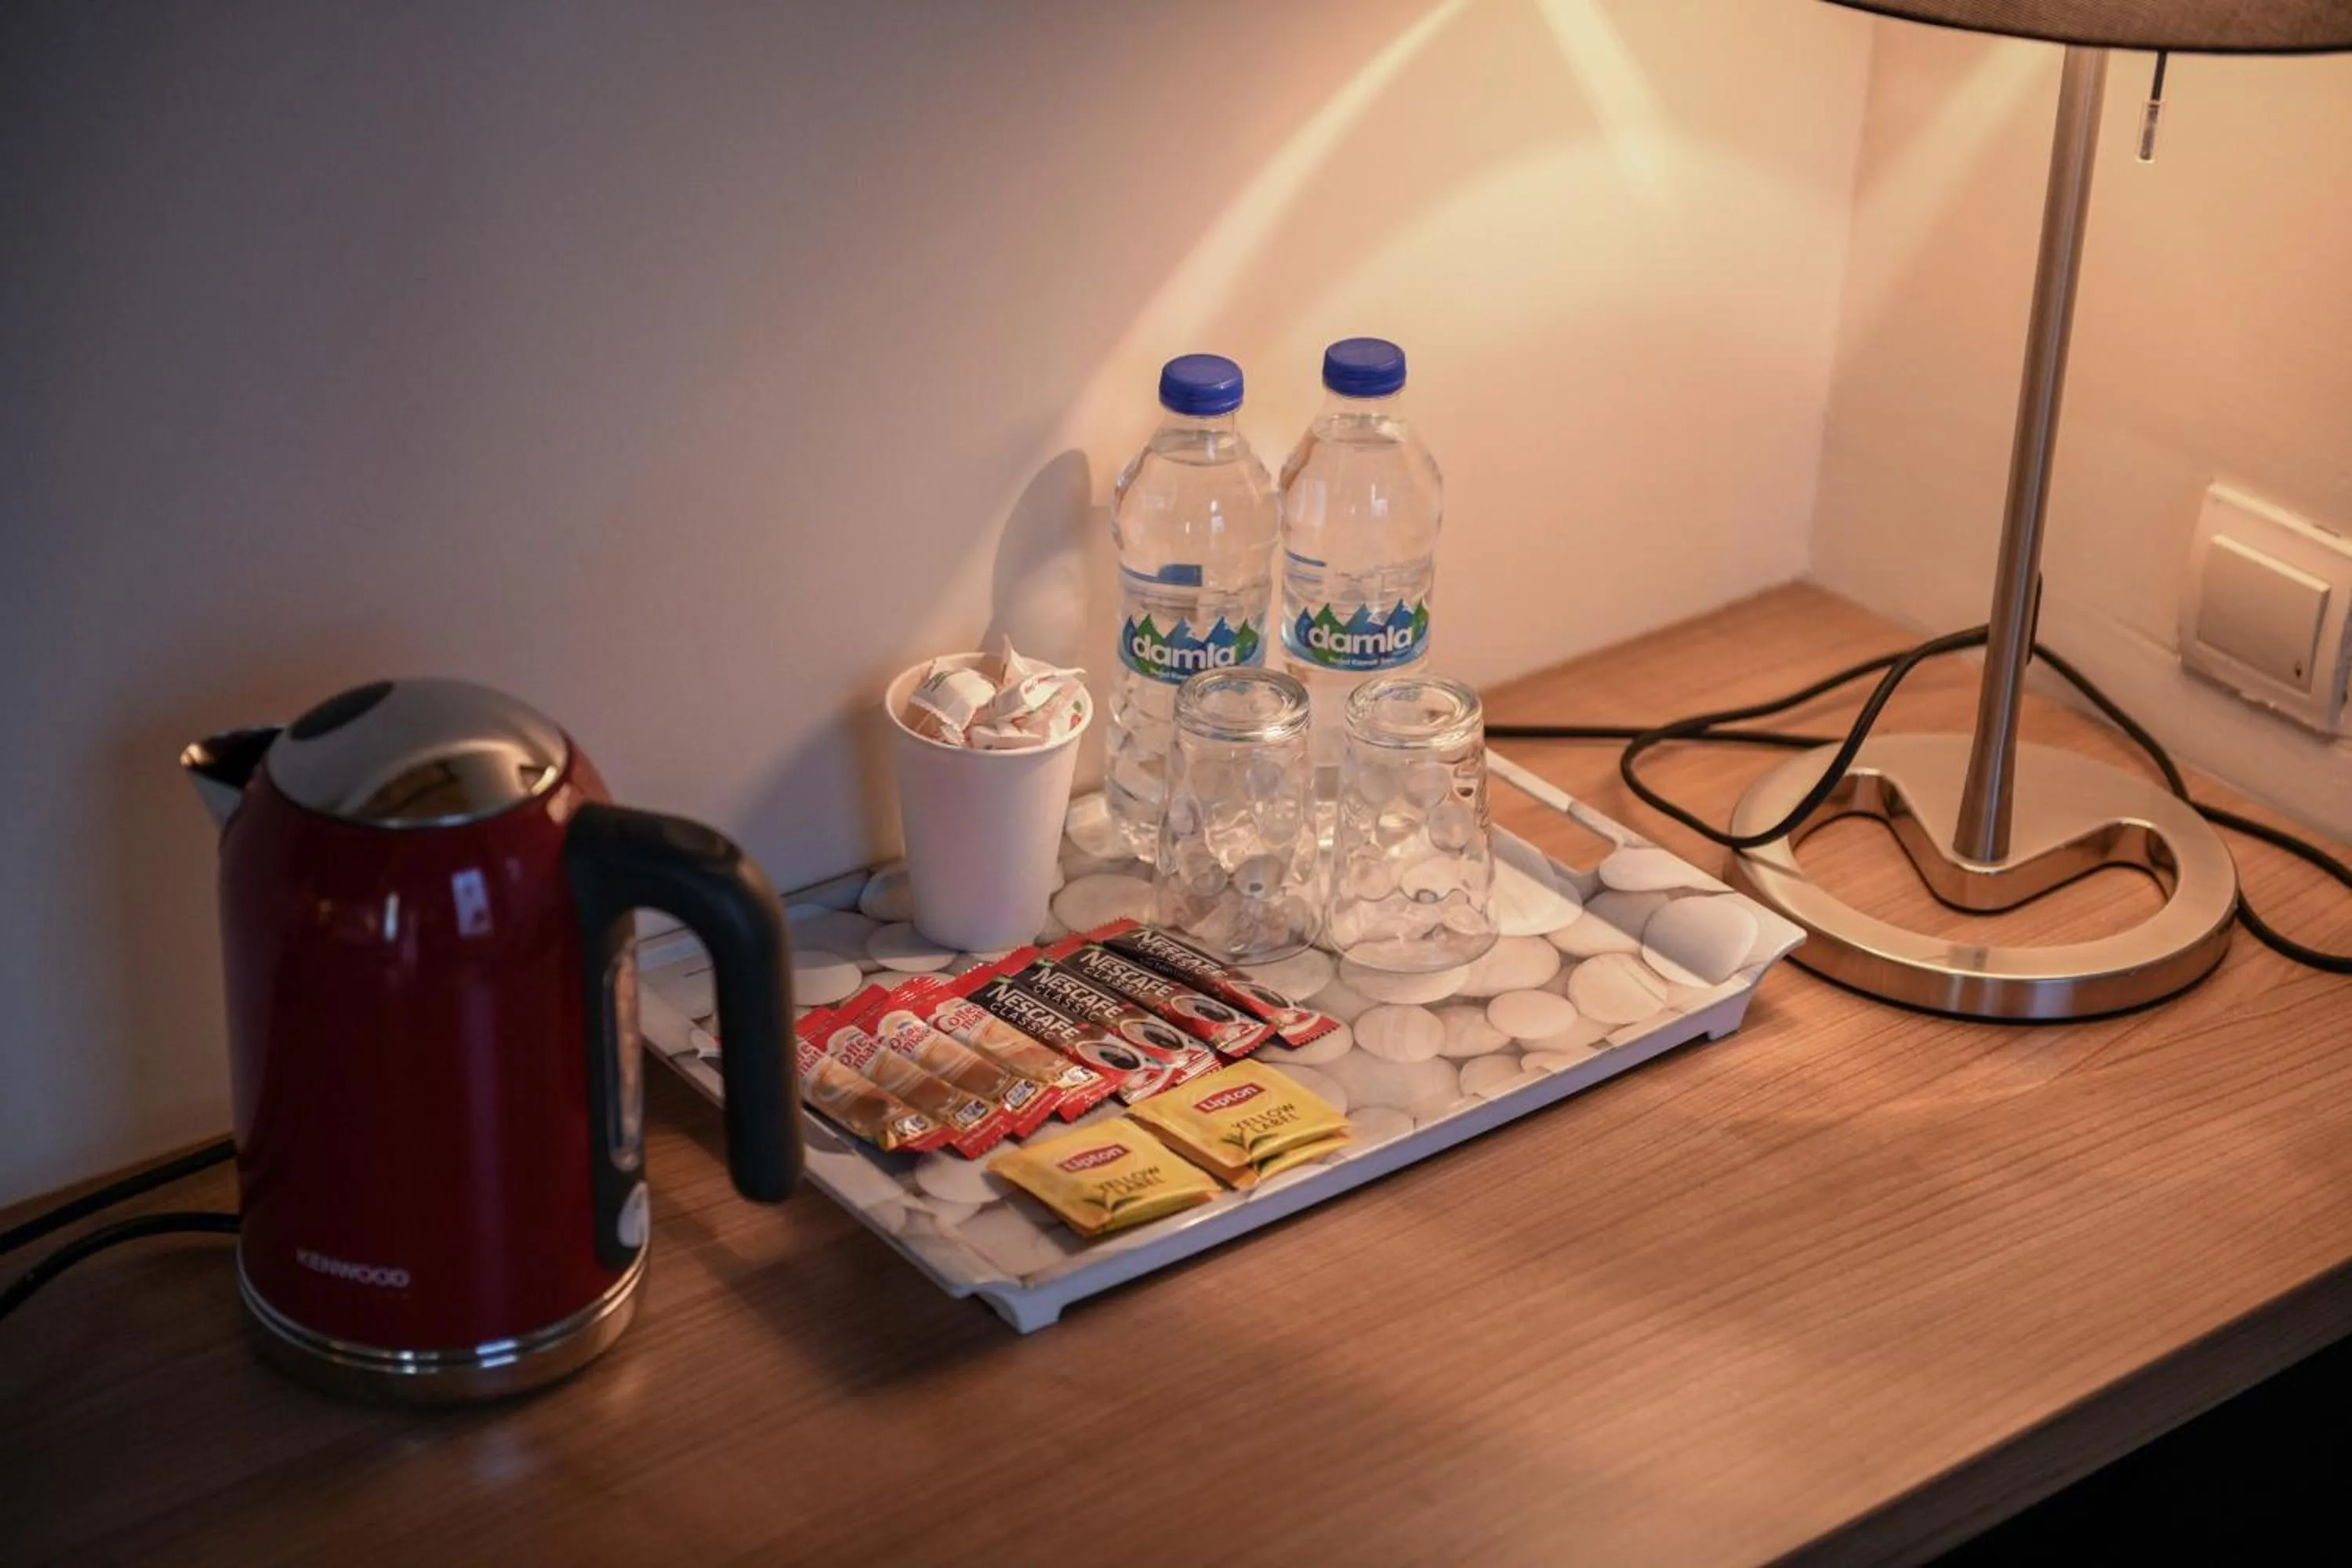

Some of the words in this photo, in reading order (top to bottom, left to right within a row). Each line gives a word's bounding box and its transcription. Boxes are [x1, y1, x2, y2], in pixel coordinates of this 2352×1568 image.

[1132, 634, 1236, 667] damla
[1308, 624, 1413, 654] damla
[1033, 984, 1100, 1022] CLASSIC
[990, 1002, 1056, 1040] CLASSIC
[1200, 1086, 1259, 1111] Lipton
[1062, 1146, 1124, 1170] Lipton
